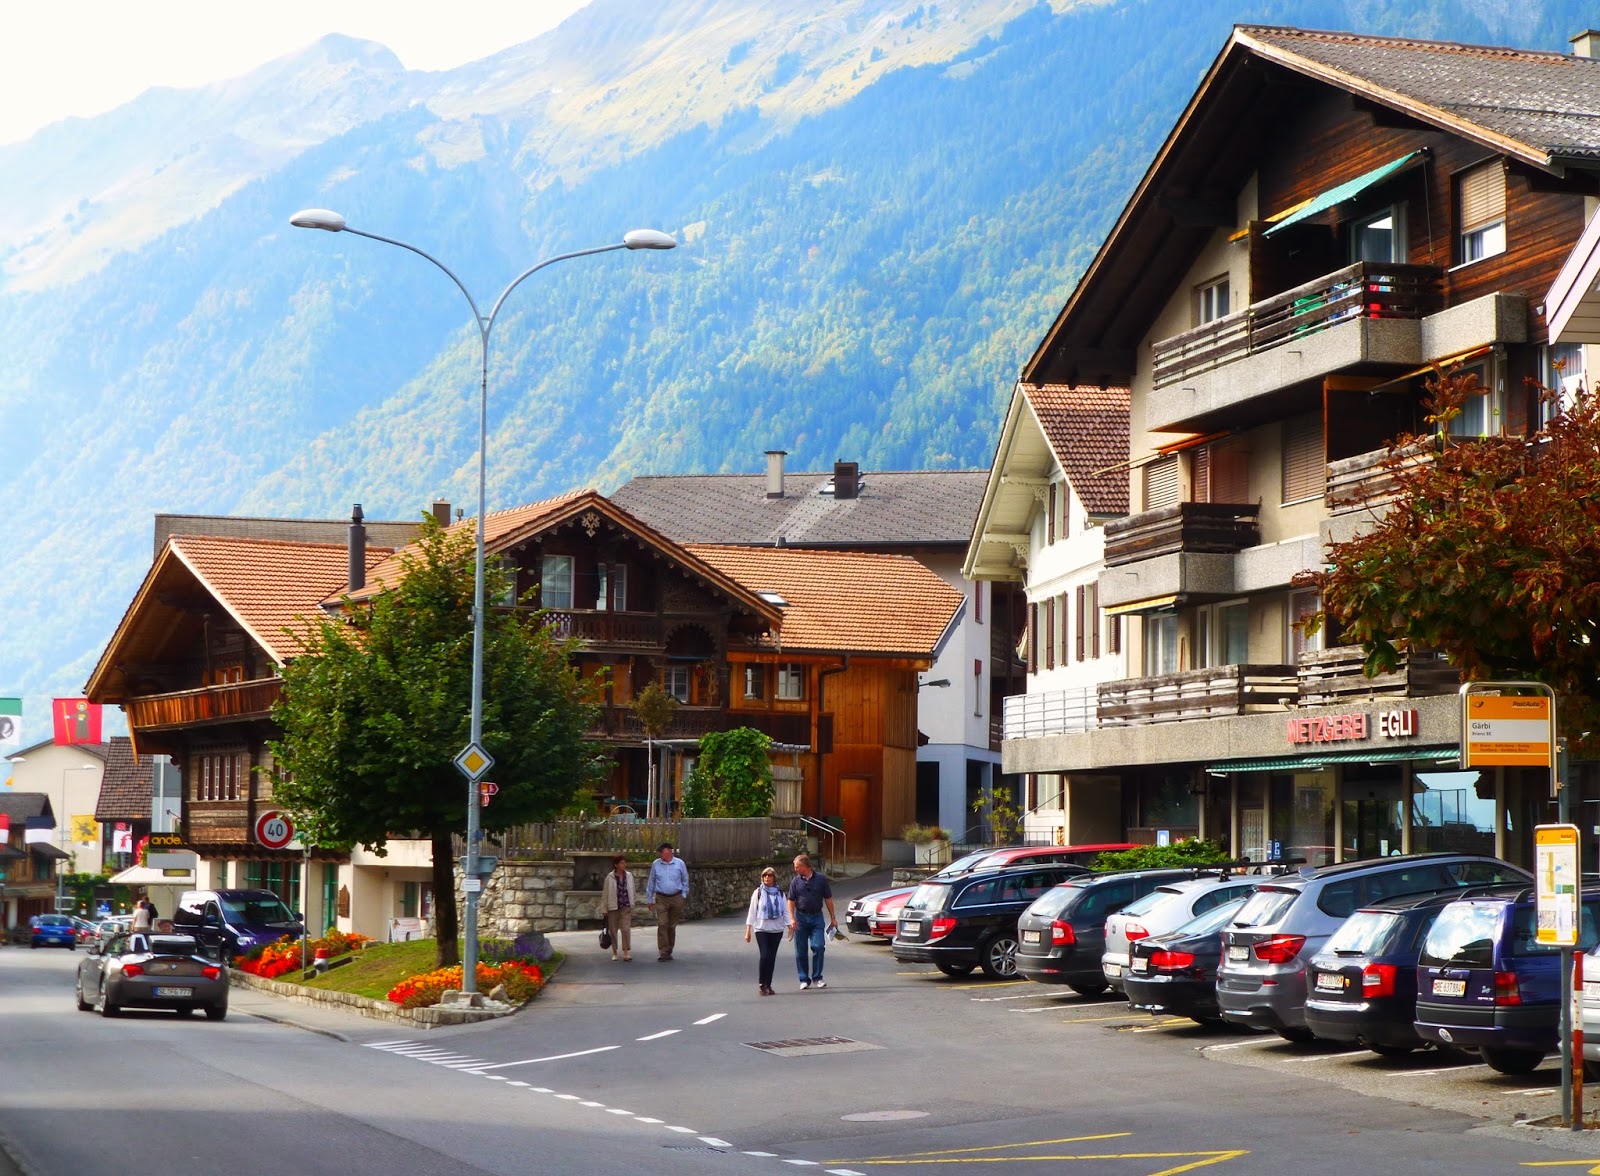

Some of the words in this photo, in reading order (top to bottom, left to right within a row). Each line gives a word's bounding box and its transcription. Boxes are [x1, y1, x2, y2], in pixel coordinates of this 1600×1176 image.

[1287, 713, 1367, 743] METZGEREI
[1379, 709, 1413, 738] EGLI
[267, 823, 284, 837] 40
[151, 834, 188, 845] ande
